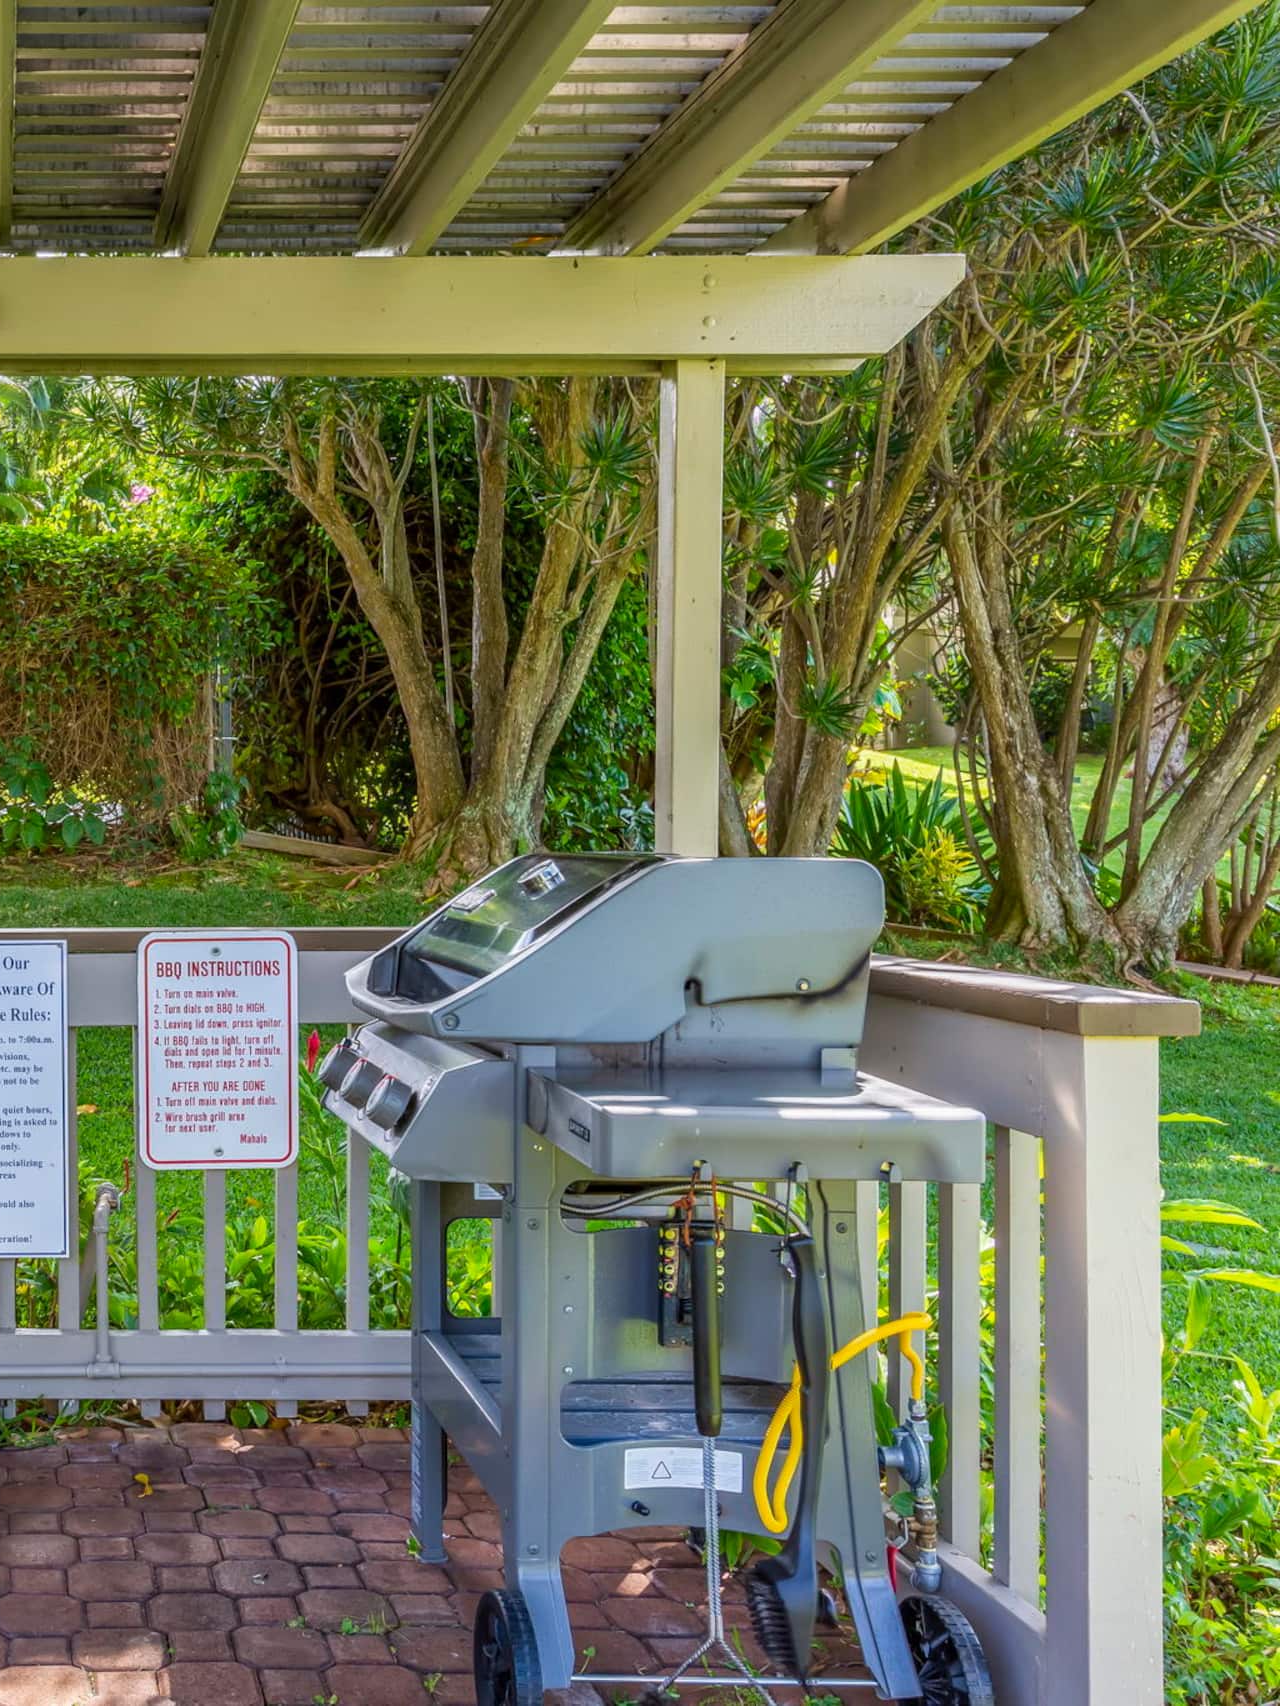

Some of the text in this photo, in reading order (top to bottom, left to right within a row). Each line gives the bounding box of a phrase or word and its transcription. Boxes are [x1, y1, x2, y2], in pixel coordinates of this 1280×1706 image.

[3, 956, 29, 970] Our
[157, 960, 280, 979] BBQ INSTRUCTIONS
[38, 982, 55, 996] Of
[165, 989, 180, 999] Turn
[196, 989, 213, 998] main
[217, 989, 238, 997] valve.
[165, 1005, 181, 1014] Turn
[184, 1004, 202, 1013] dials
[217, 1004, 232, 1014] BBQ
[236, 1004, 244, 1012] to
[11, 1008, 51, 1022] Rules:
[164, 1020, 192, 1031] Leaving
[196, 1019, 204, 1028] lid
[232, 1020, 253, 1029] press
[34, 1065, 43, 1073] be
[189, 1059, 213, 1070] repeat
[216, 1059, 237, 1069] steps
[240, 1059, 244, 1067] 2
[248, 1058, 261, 1067] and
[172, 1081, 265, 1092] AFTER YOU ARE DONE
[165, 1097, 181, 1106] Turn
[185, 1097, 195, 1106] off
[199, 1096, 216, 1106] main
[220, 1096, 238, 1105] valve
[242, 1096, 255, 1105] and
[258, 1096, 277, 1105] dials.
[2, 1107, 23, 1115] quiet
[24, 1118, 47, 1126] asked
[165, 1113, 183, 1122] Wire
[186, 1113, 207, 1122] brush
[210, 1112, 225, 1123] grill
[240, 1134, 267, 1144] Mahalo
[1, 1143, 21, 1152] only.
[0, 1160, 43, 1169] socializing
